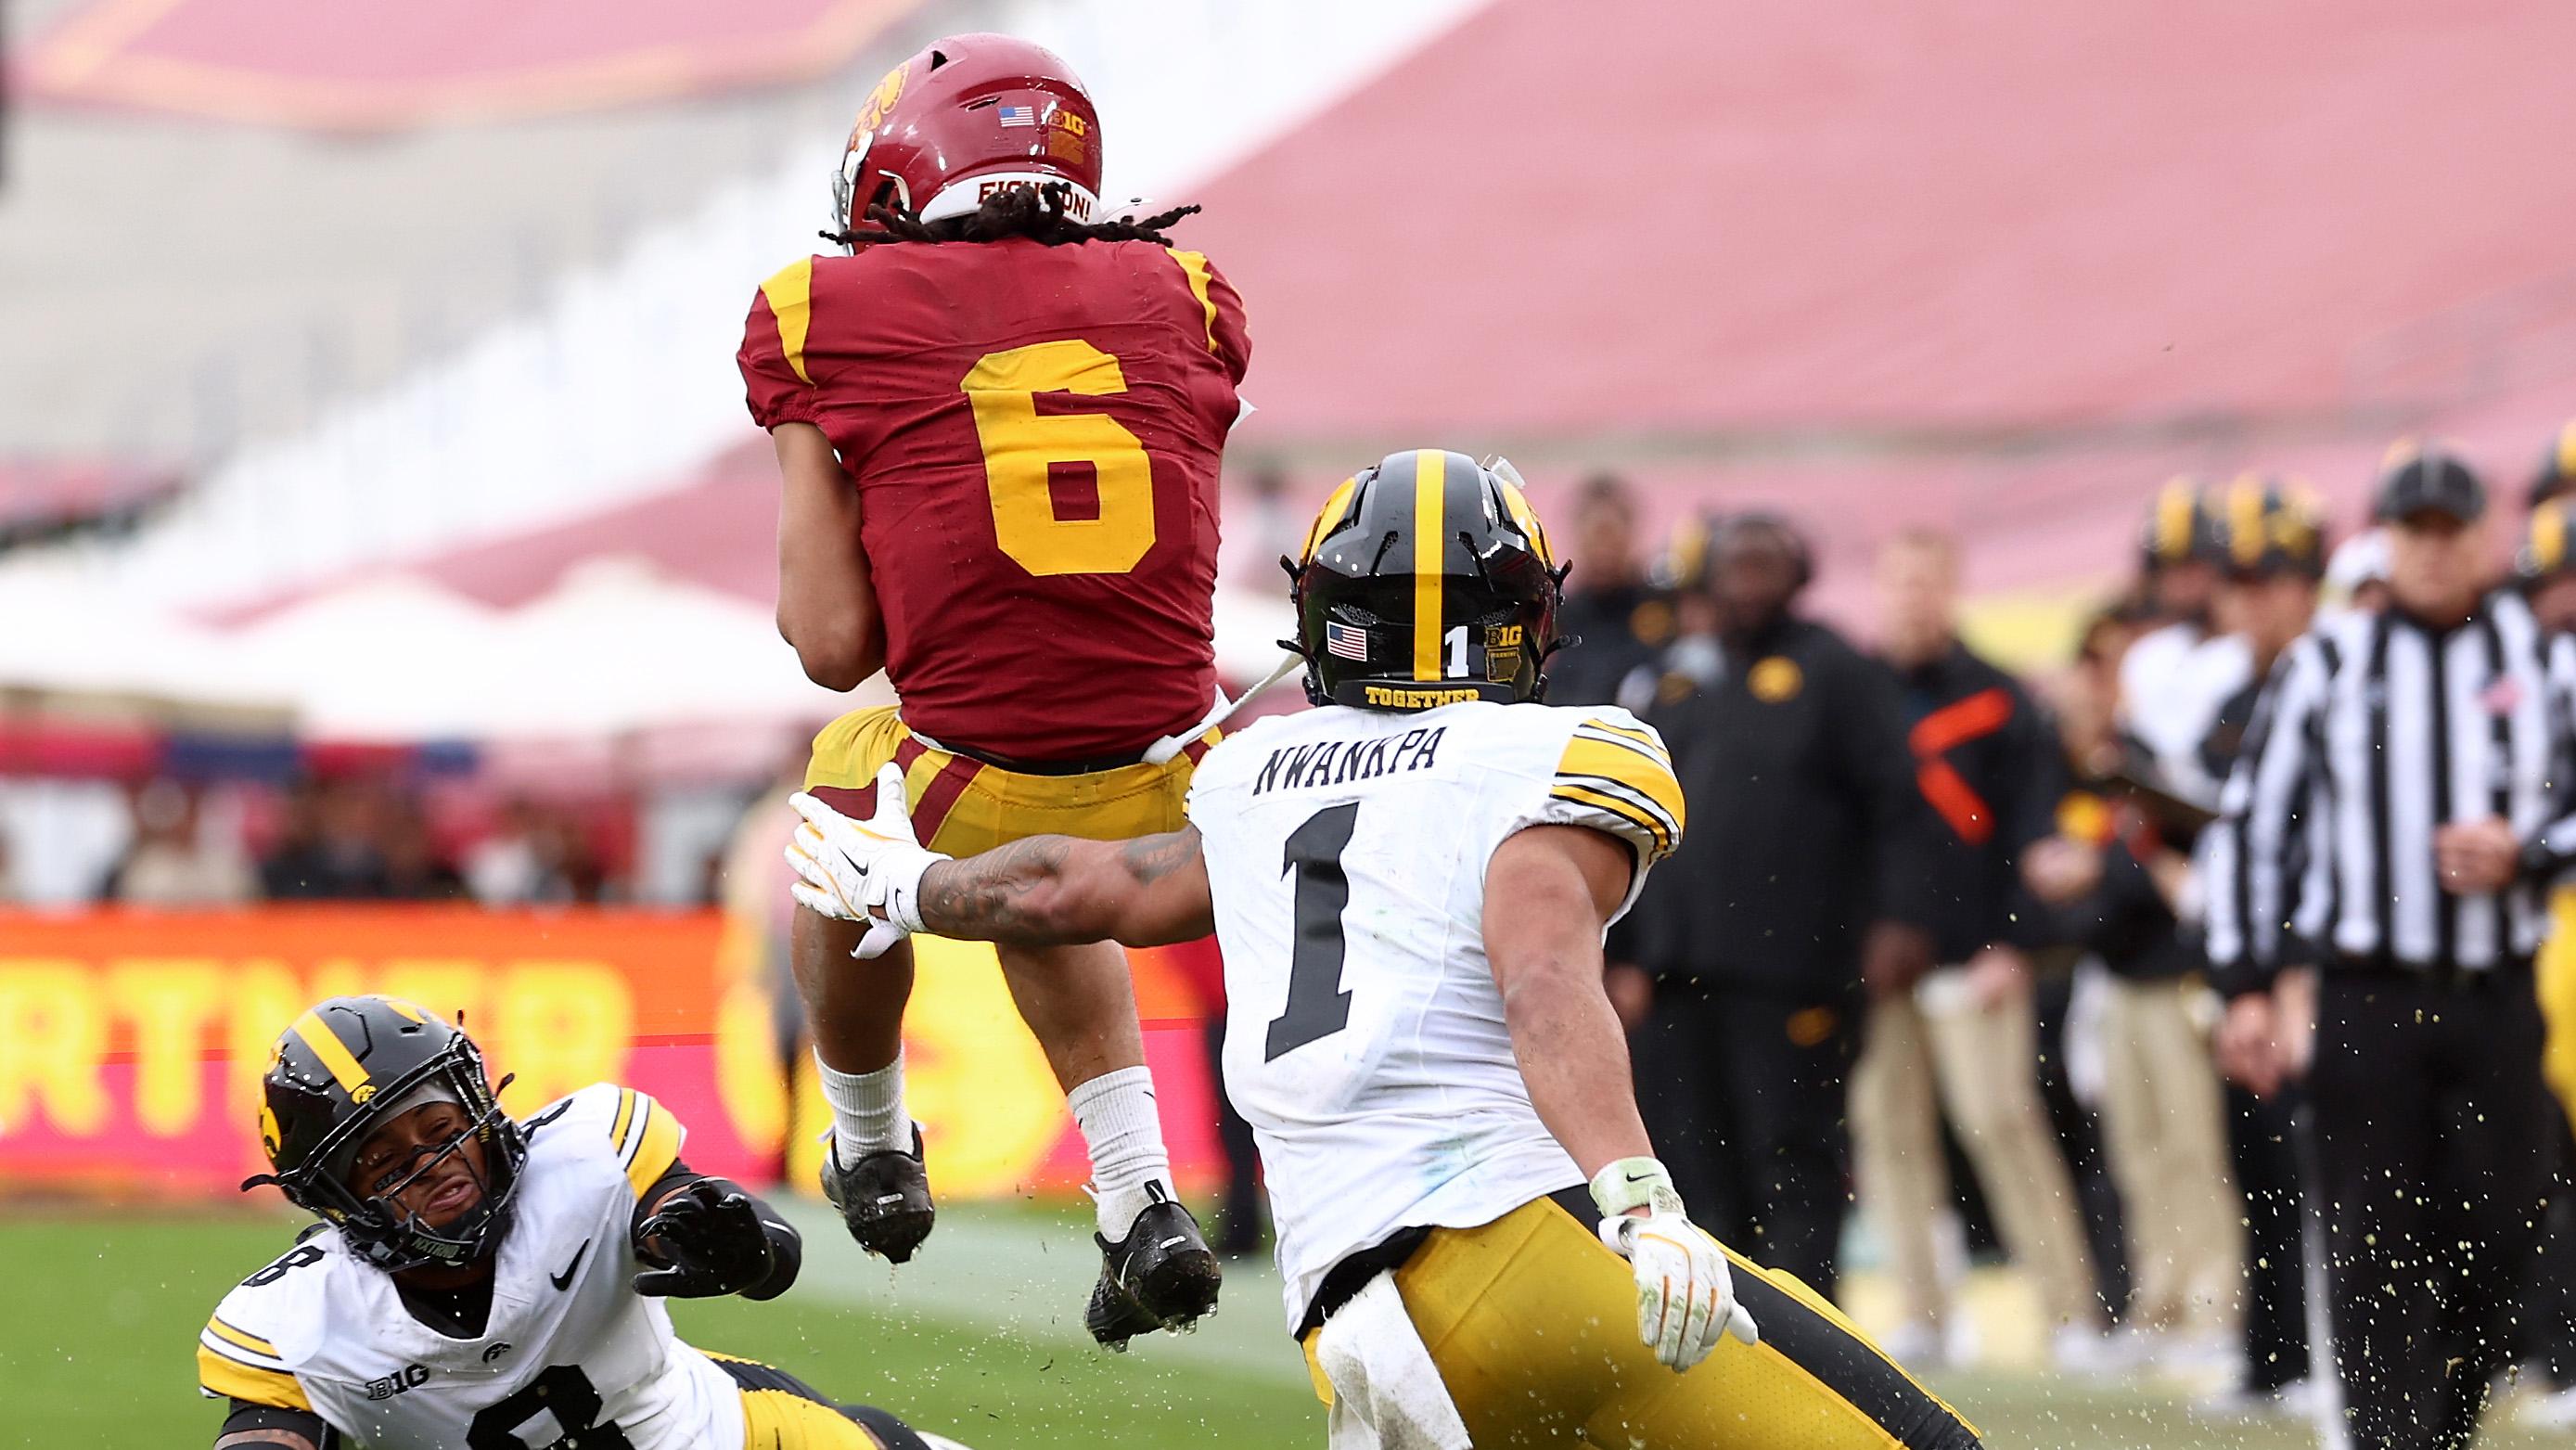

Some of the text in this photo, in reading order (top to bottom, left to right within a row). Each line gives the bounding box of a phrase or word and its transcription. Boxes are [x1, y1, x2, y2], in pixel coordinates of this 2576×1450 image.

[959, 339, 1157, 577] 6
[1444, 625, 1470, 679] 1
[1252, 726, 1447, 796] NWANKPA
[1264, 802, 1360, 1064] 1
[241, 1245, 326, 1288] 8
